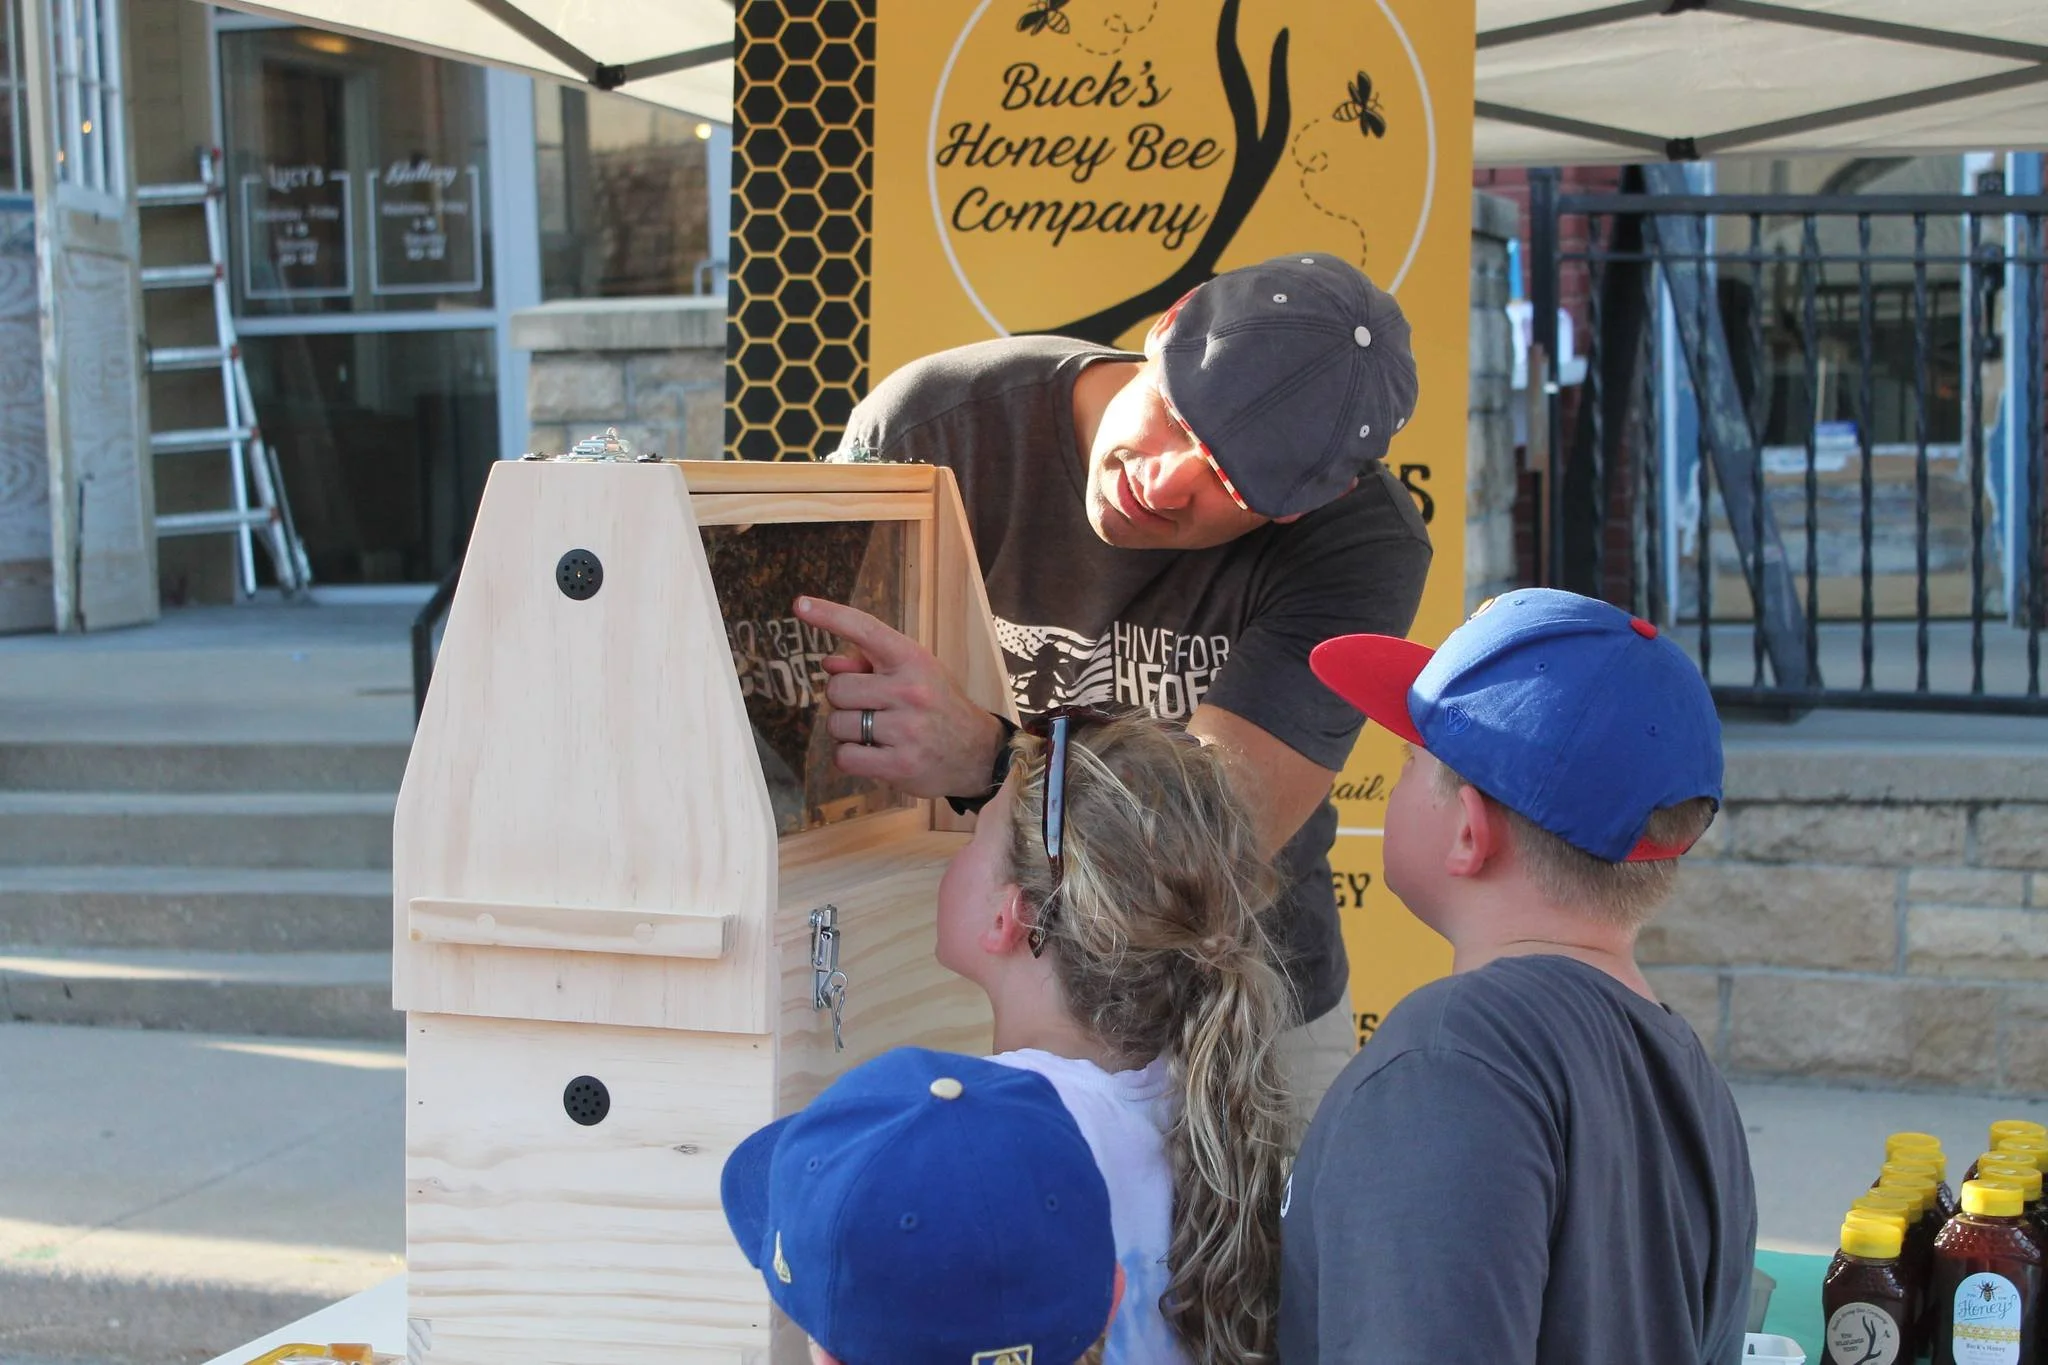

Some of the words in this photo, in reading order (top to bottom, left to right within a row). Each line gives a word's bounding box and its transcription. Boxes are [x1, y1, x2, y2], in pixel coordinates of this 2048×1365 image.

[1001, 60, 1172, 111] Buck's
[936, 122, 1117, 183] Honey
[1126, 123, 1226, 171] Bee
[952, 186, 1208, 250] Company
[1113, 620, 1175, 666] HIVE
[1175, 634, 1230, 674] FOR
[1958, 1294, 2018, 1319] Honey
